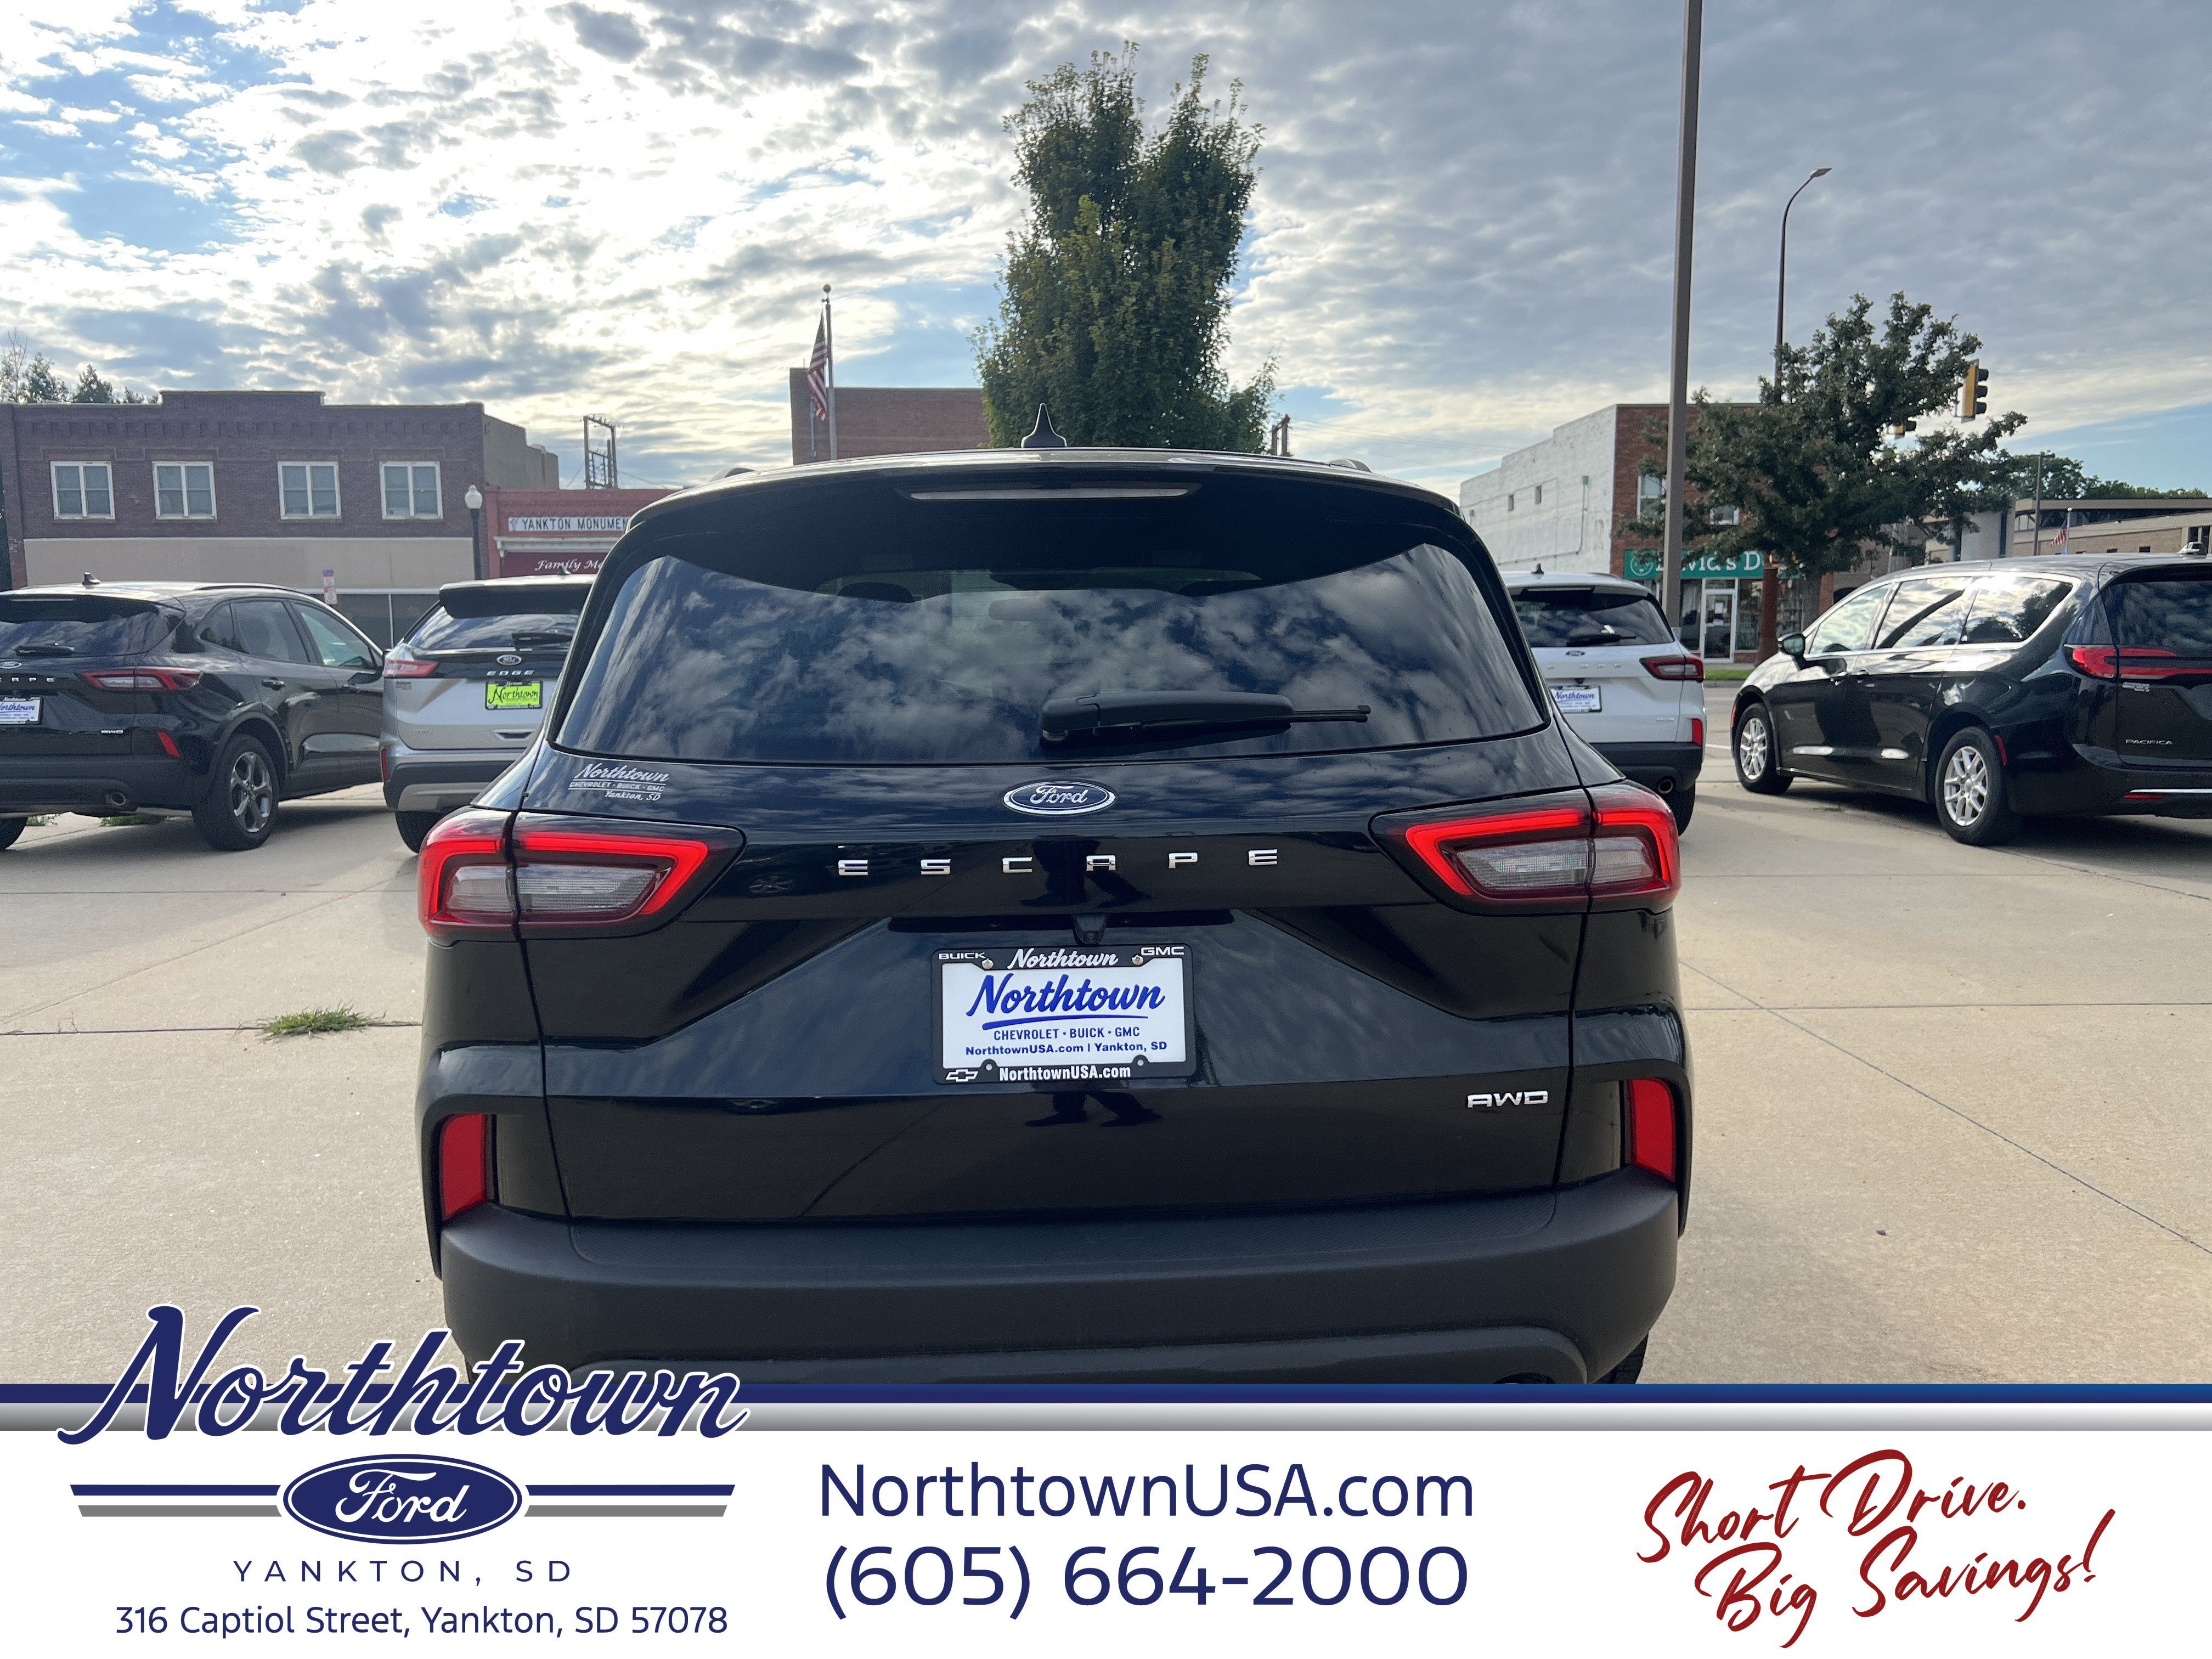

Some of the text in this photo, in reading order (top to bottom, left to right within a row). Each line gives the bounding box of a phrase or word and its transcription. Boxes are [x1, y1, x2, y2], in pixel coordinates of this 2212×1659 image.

[522, 517, 571, 531] YANKTON
[534, 558, 582, 572] Family
[488, 686, 538, 703] Northtown
[574, 763, 669, 782] Northtown
[569, 781, 665, 793] CHEVROLET BUICK GMC
[605, 789, 662, 802] Yankton, SD
[1030, 785, 1090, 805] Ford
[838, 849, 1278, 876] ESCAPE
[939, 946, 1184, 970] BUICK Northtown GMC
[966, 973, 1165, 1017] Northtown
[994, 1026, 1140, 1041] CHEVROLET BUICK GMC
[966, 1041, 1167, 1056] NorthtownUSA.com Yankton, SD
[999, 1065, 1131, 1082] NorthtownUSA.com
[1468, 1091, 1548, 1108] AWD
